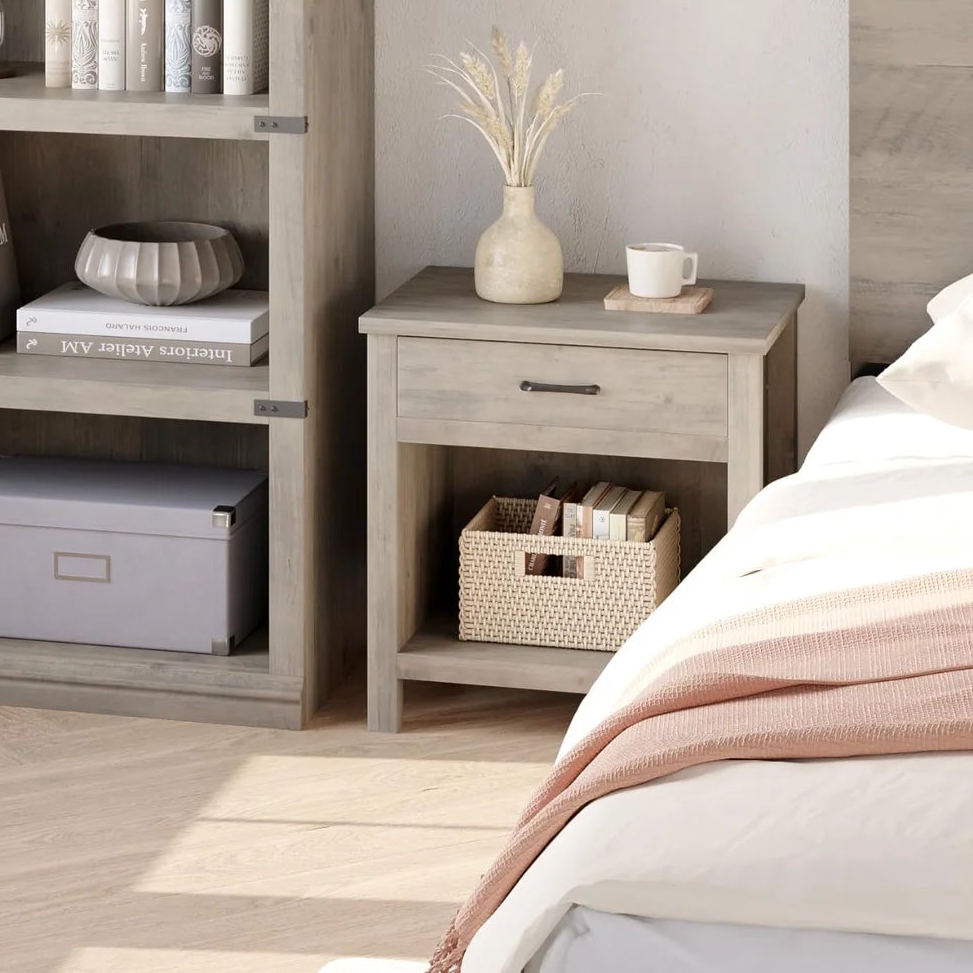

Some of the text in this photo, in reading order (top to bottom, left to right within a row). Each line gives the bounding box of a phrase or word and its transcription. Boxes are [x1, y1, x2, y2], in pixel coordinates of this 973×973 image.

[105, 322, 141, 331] HALARD
[60, 339, 234, 363] Interiors Atelier AM
